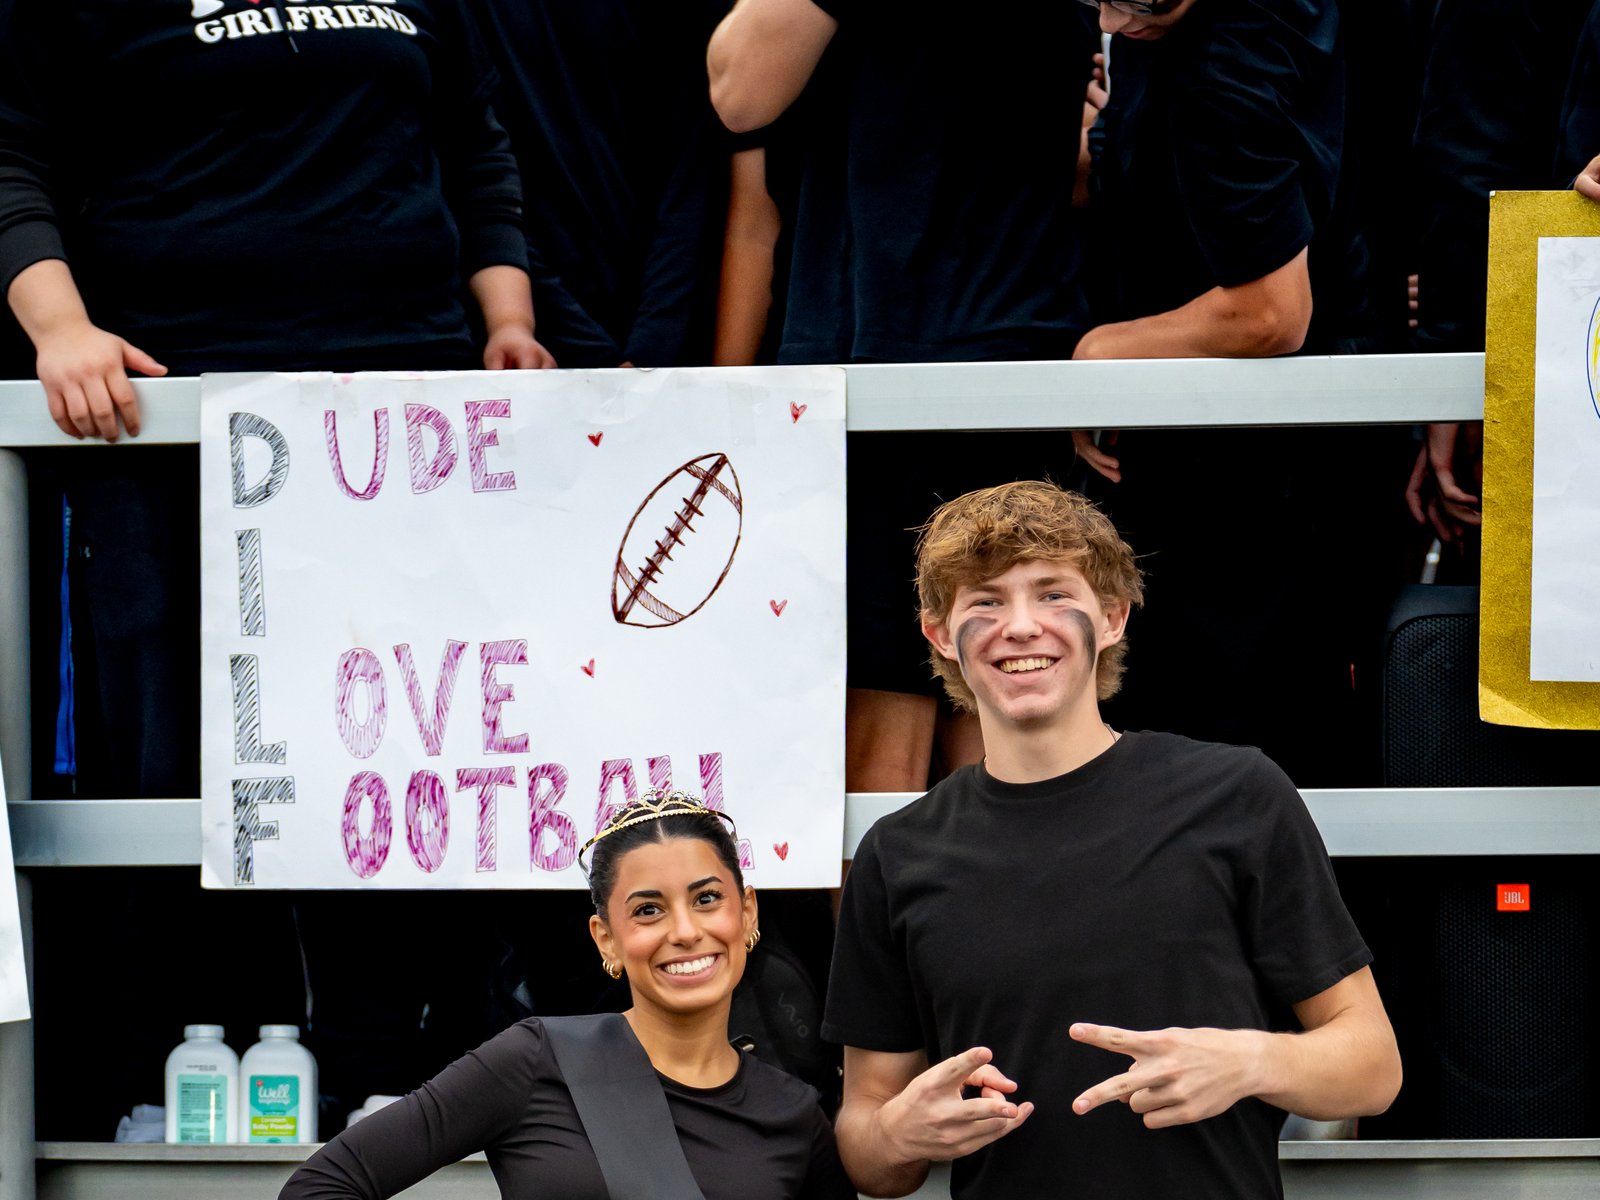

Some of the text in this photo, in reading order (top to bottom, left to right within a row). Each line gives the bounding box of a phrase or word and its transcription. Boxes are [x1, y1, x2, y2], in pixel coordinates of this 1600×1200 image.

[195, 5, 417, 43] GIRLFRIEND
[235, 528, 265, 636] I
[1504, 891, 1525, 904] JBL
